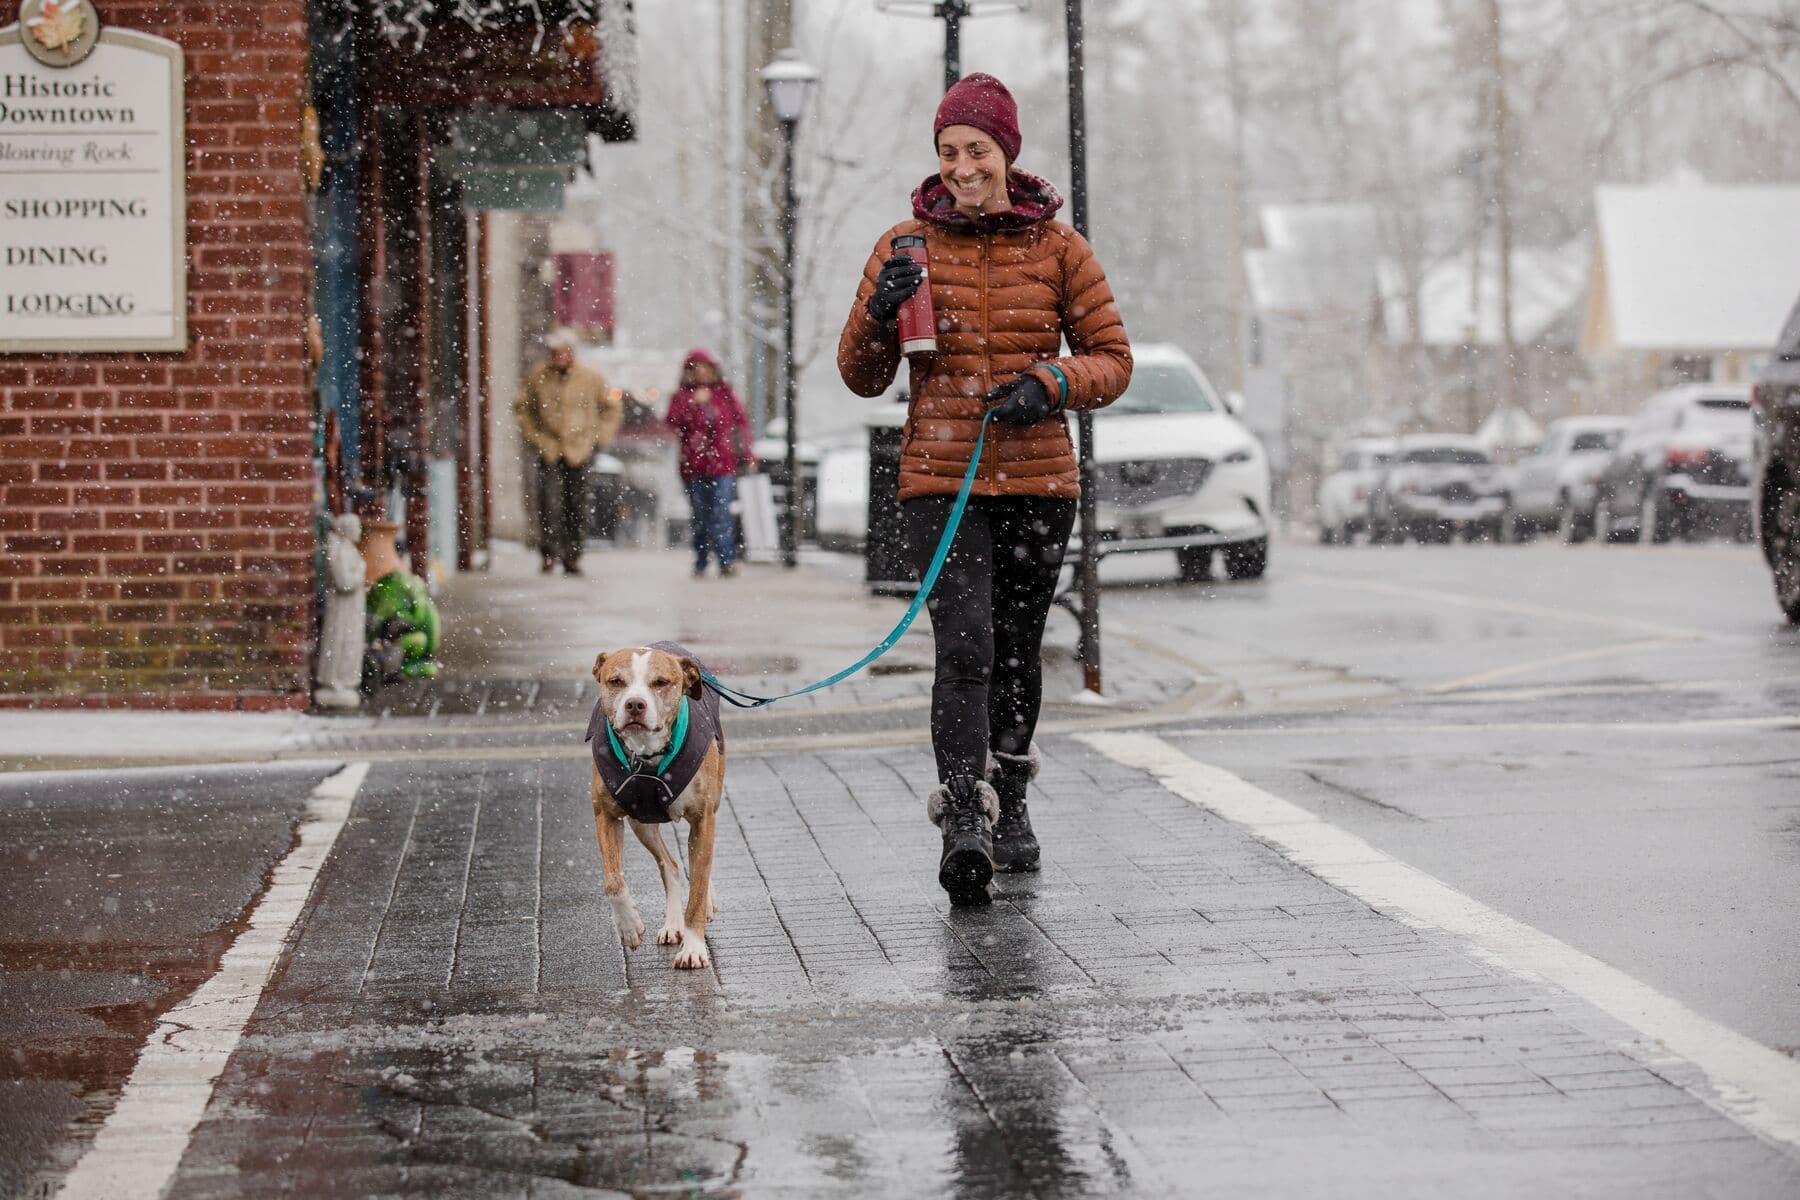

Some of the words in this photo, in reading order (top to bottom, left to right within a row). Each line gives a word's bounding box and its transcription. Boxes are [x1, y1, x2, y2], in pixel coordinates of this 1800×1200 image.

[5, 74, 116, 97] Historic
[84, 141, 132, 164] Rock
[5, 199, 147, 218] SHOPPING
[7, 247, 108, 265] DINING
[7, 294, 134, 315] LODGING
